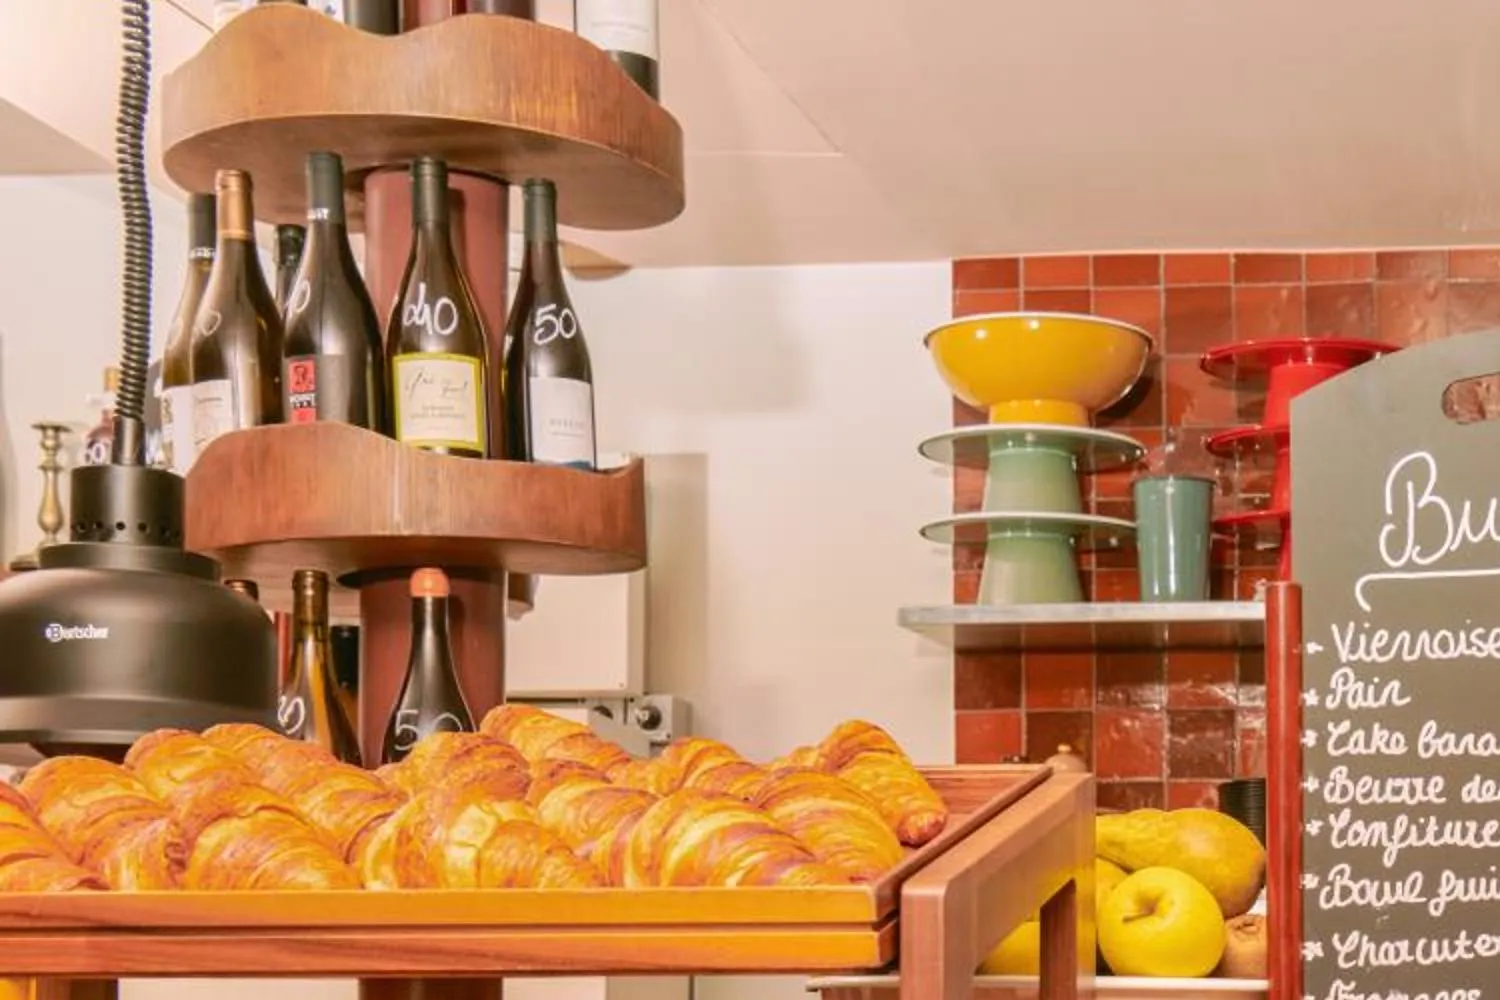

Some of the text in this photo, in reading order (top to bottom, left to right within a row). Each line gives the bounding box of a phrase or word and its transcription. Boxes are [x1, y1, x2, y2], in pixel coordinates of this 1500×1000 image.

[534, 303, 577, 345] 50
[1325, 667, 1412, 710] Pain
[1326, 719, 1409, 757] Cake
[1323, 765, 1447, 805] Beurre
